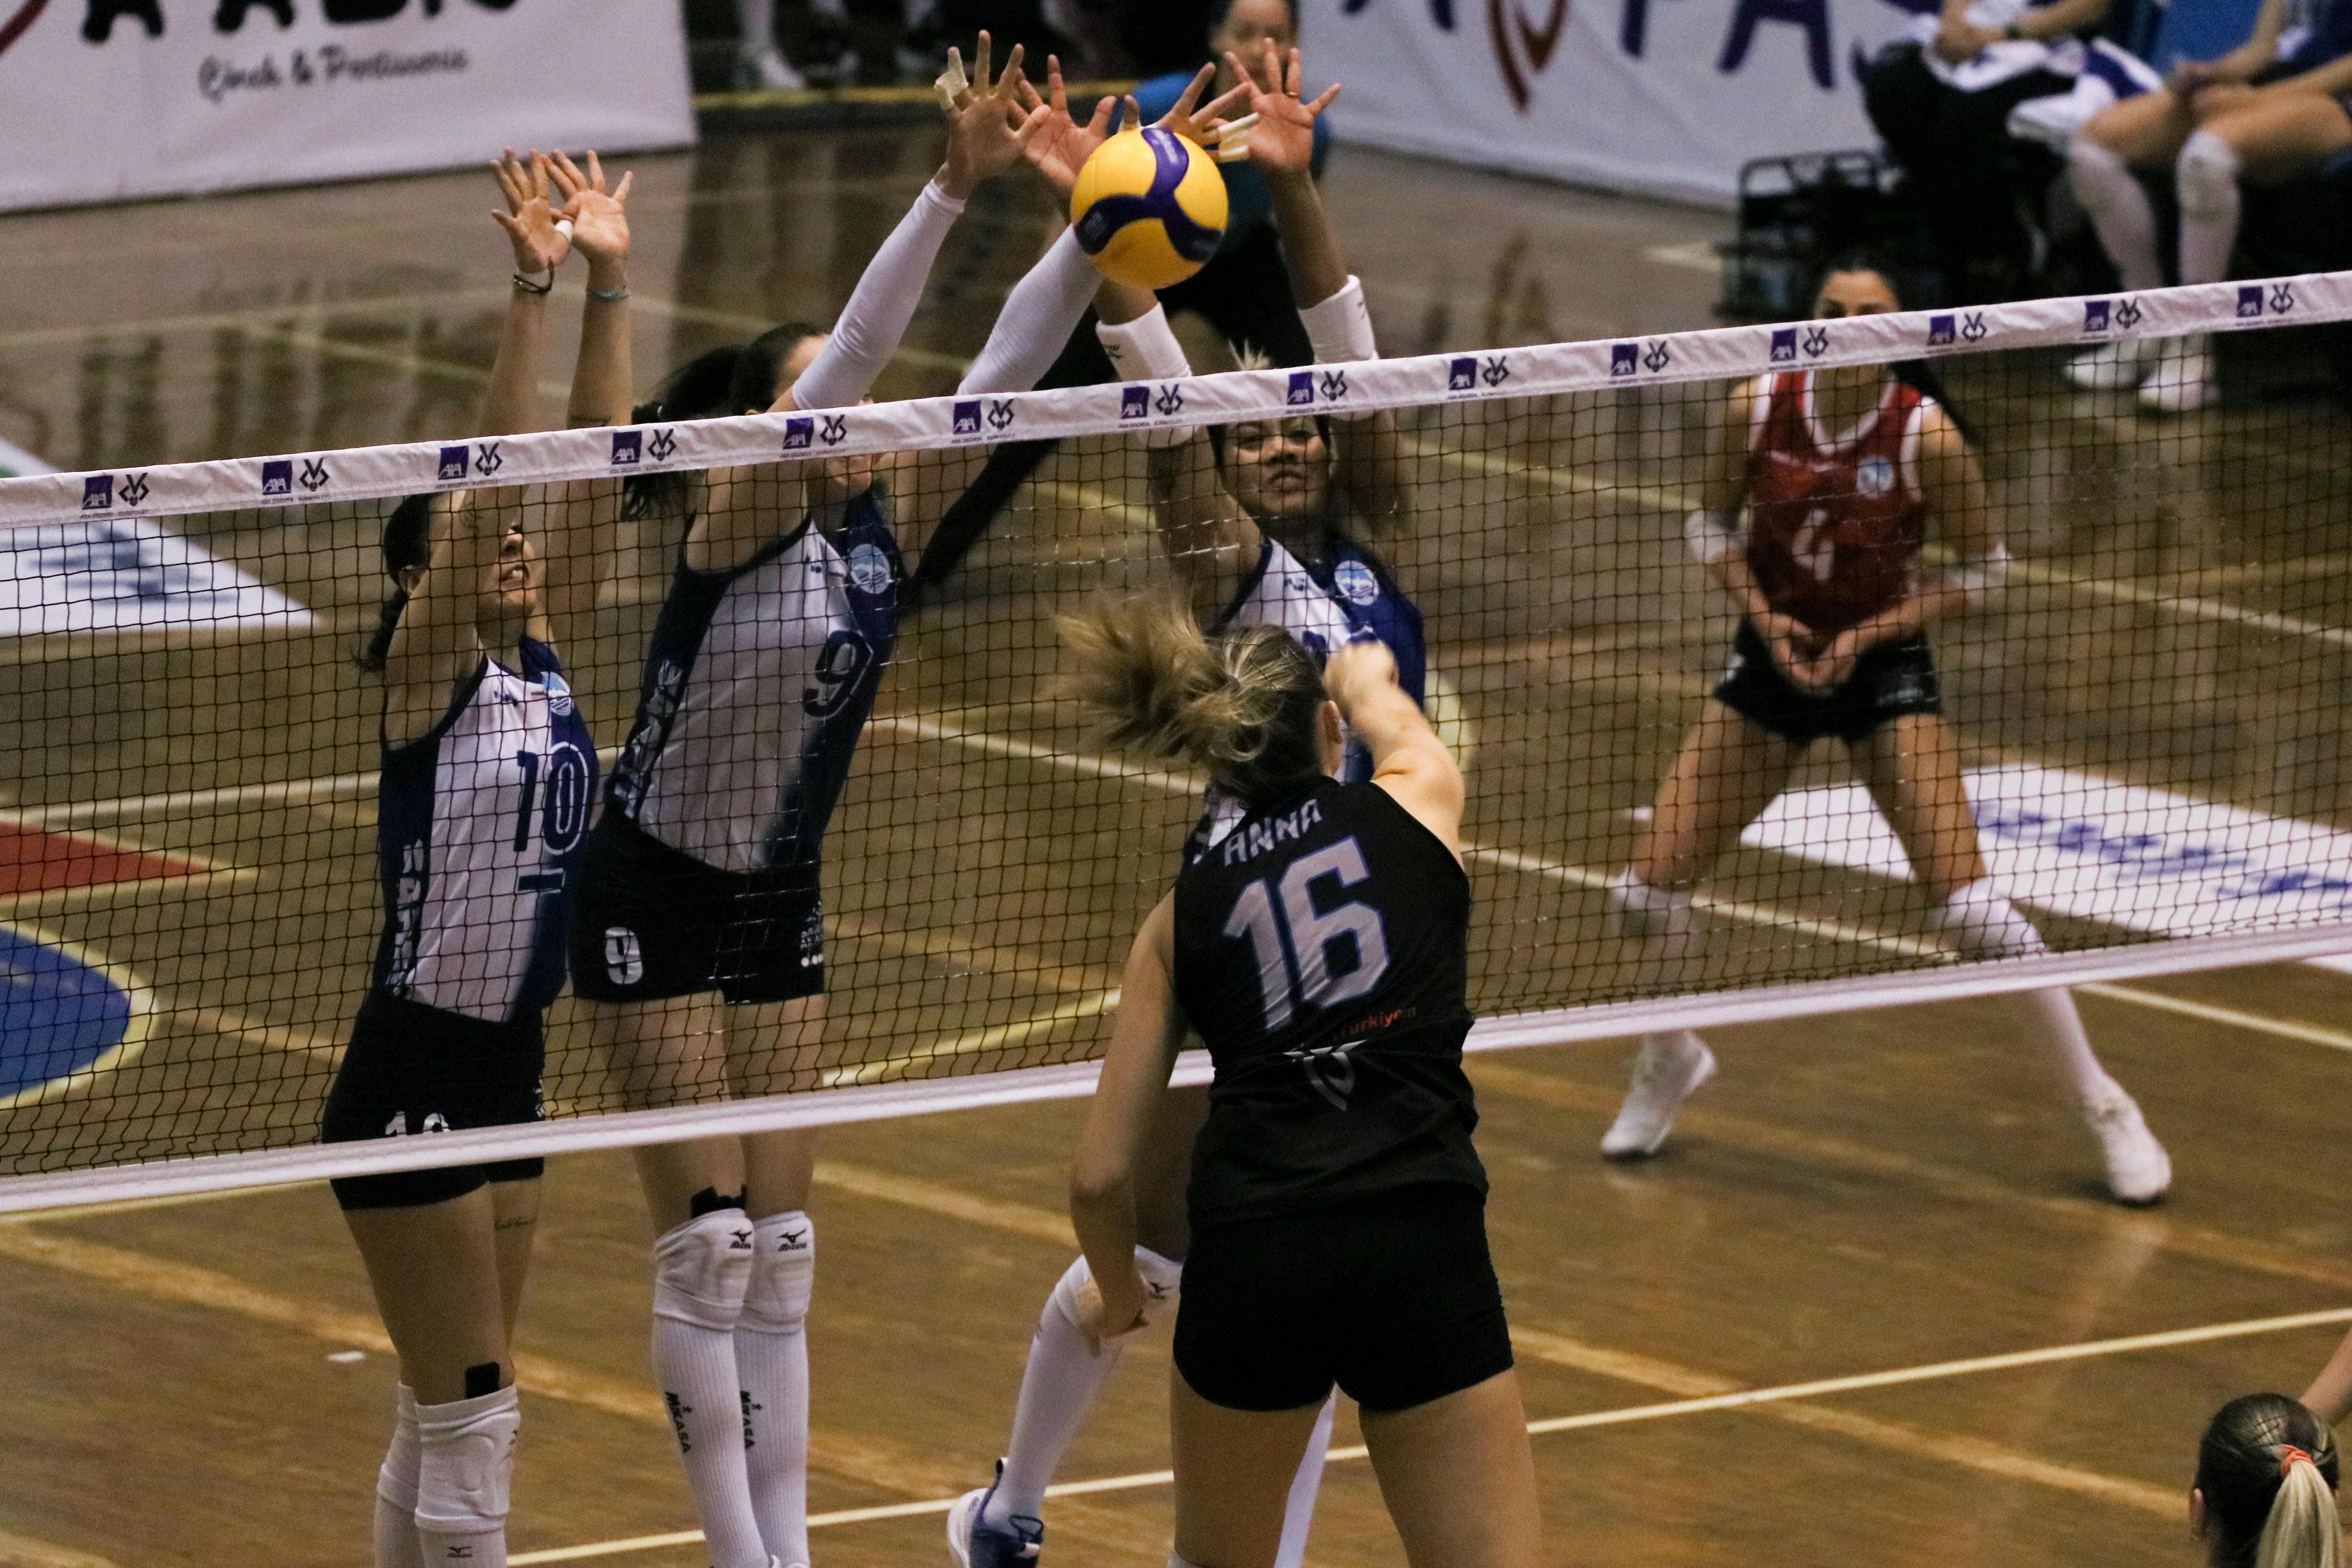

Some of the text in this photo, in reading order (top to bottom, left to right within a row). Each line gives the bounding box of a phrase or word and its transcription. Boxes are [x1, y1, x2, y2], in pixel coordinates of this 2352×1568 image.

[1288, 389, 1309, 403] AXA
[1122, 403, 1143, 417] AXA
[954, 418, 976, 432] AXA
[783, 434, 806, 446] AXA
[612, 448, 634, 462] AXA
[439, 463, 461, 477] AXA
[263, 478, 286, 492] AXA
[83, 493, 107, 506] AXA
[802, 630, 873, 719] 9
[514, 742, 588, 855] 10
[1222, 837, 1390, 1031] 16
[605, 926, 643, 984] 9
